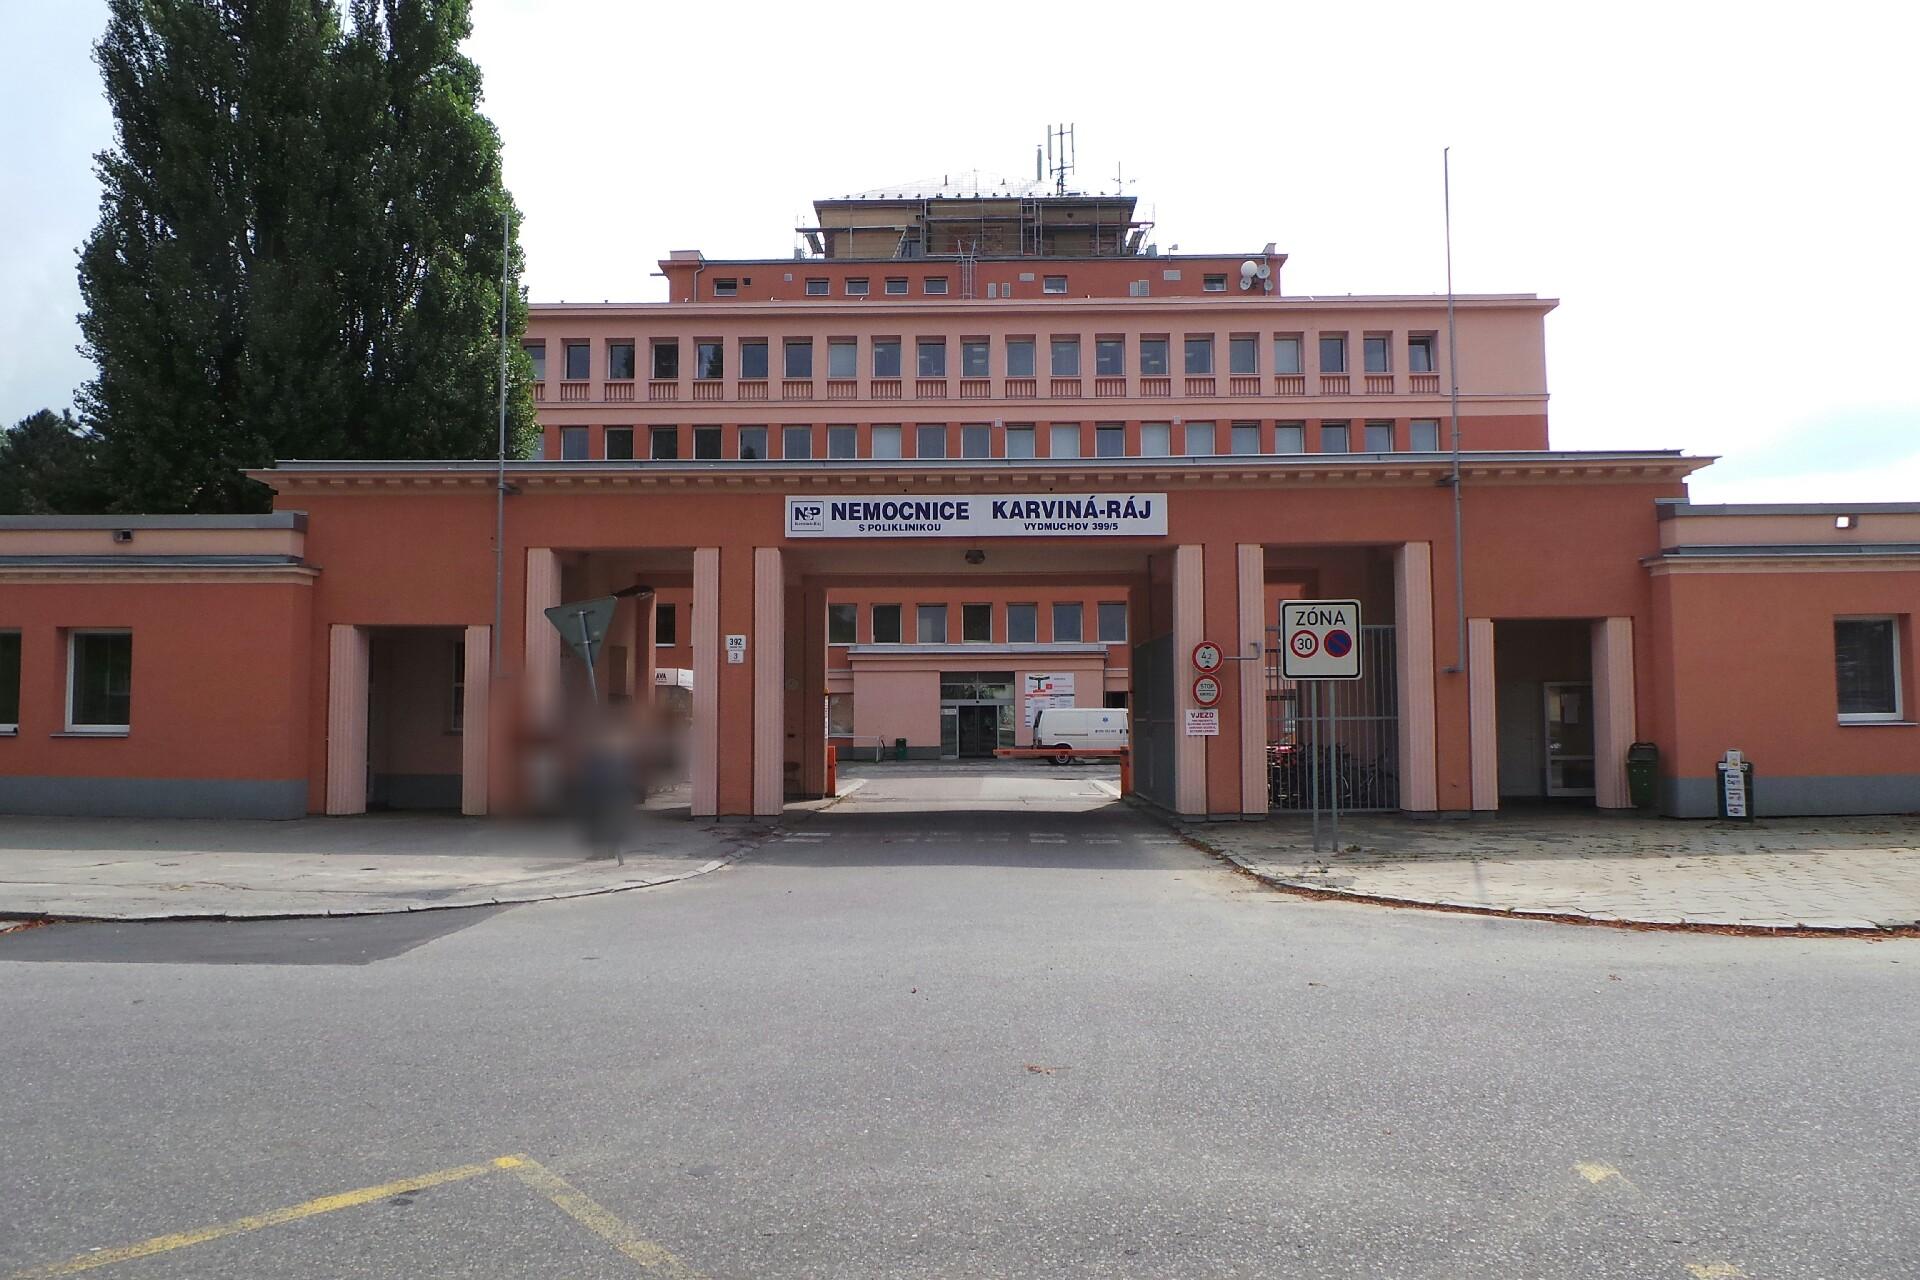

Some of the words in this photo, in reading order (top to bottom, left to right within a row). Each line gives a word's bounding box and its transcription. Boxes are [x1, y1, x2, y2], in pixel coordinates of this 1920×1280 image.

[831, 502, 970, 521] NEMOCNICE
[992, 496, 1151, 519] KARVINÁ-RÁJ
[858, 524, 865, 532] S
[868, 523, 941, 532] POLIKLINIKOU
[1024, 522, 1089, 531] VYDMUCHOV
[1092, 522, 1119, 531] 399/5
[1295, 606, 1346, 626] ZÓNA
[730, 638, 742, 646] 392
[1297, 638, 1313, 650] 30
